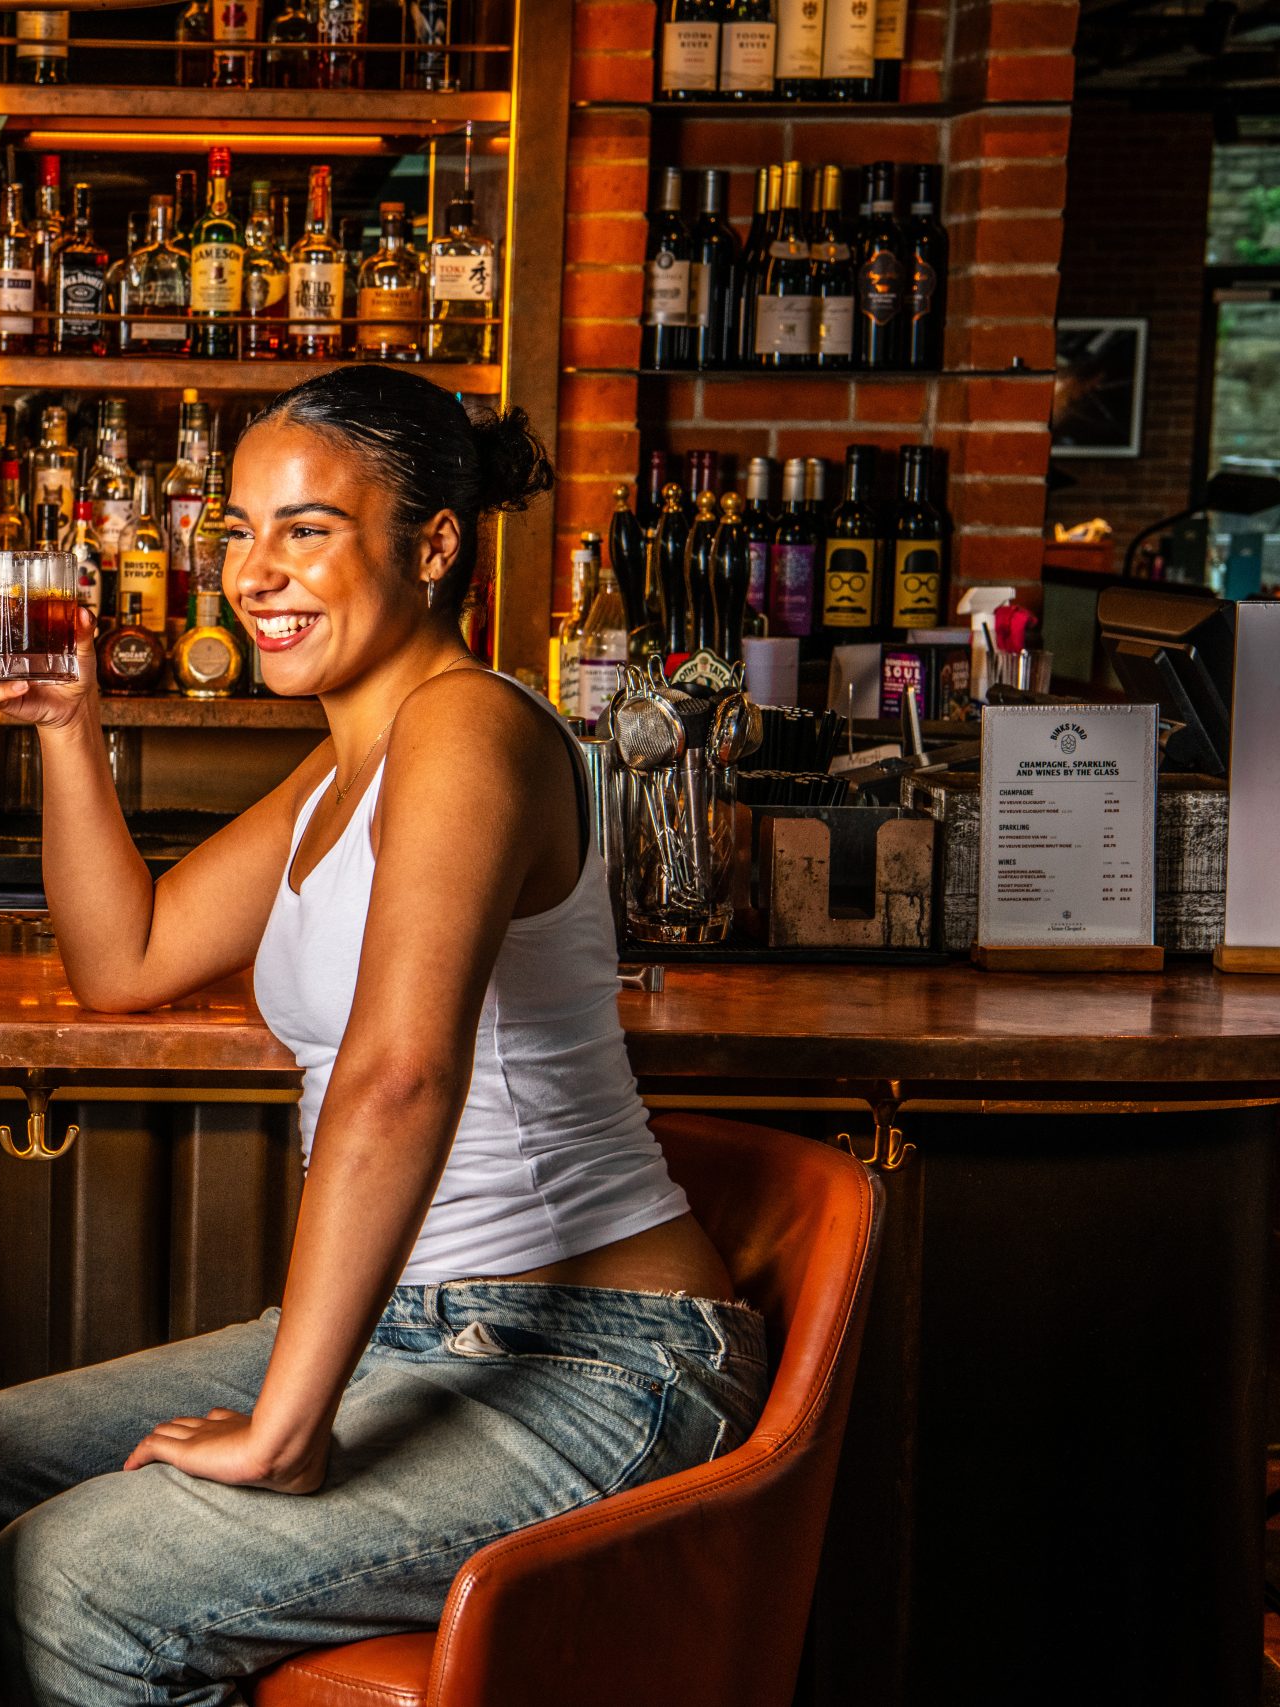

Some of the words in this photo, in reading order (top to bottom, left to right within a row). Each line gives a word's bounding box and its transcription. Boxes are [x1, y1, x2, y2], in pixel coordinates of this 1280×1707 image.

[194, 247, 240, 263] JAMESON
[440, 265, 465, 273] TOKI
[124, 562, 161, 570] BRISTOL
[124, 570, 153, 578] SYRUP
[679, 663, 698, 682] OTHY
[885, 665, 920, 680] SOUL
[1050, 723, 1070, 740] BINKS
[1072, 723, 1087, 740] YARD
[1020, 761, 1070, 769] CHAMPAGNE,
